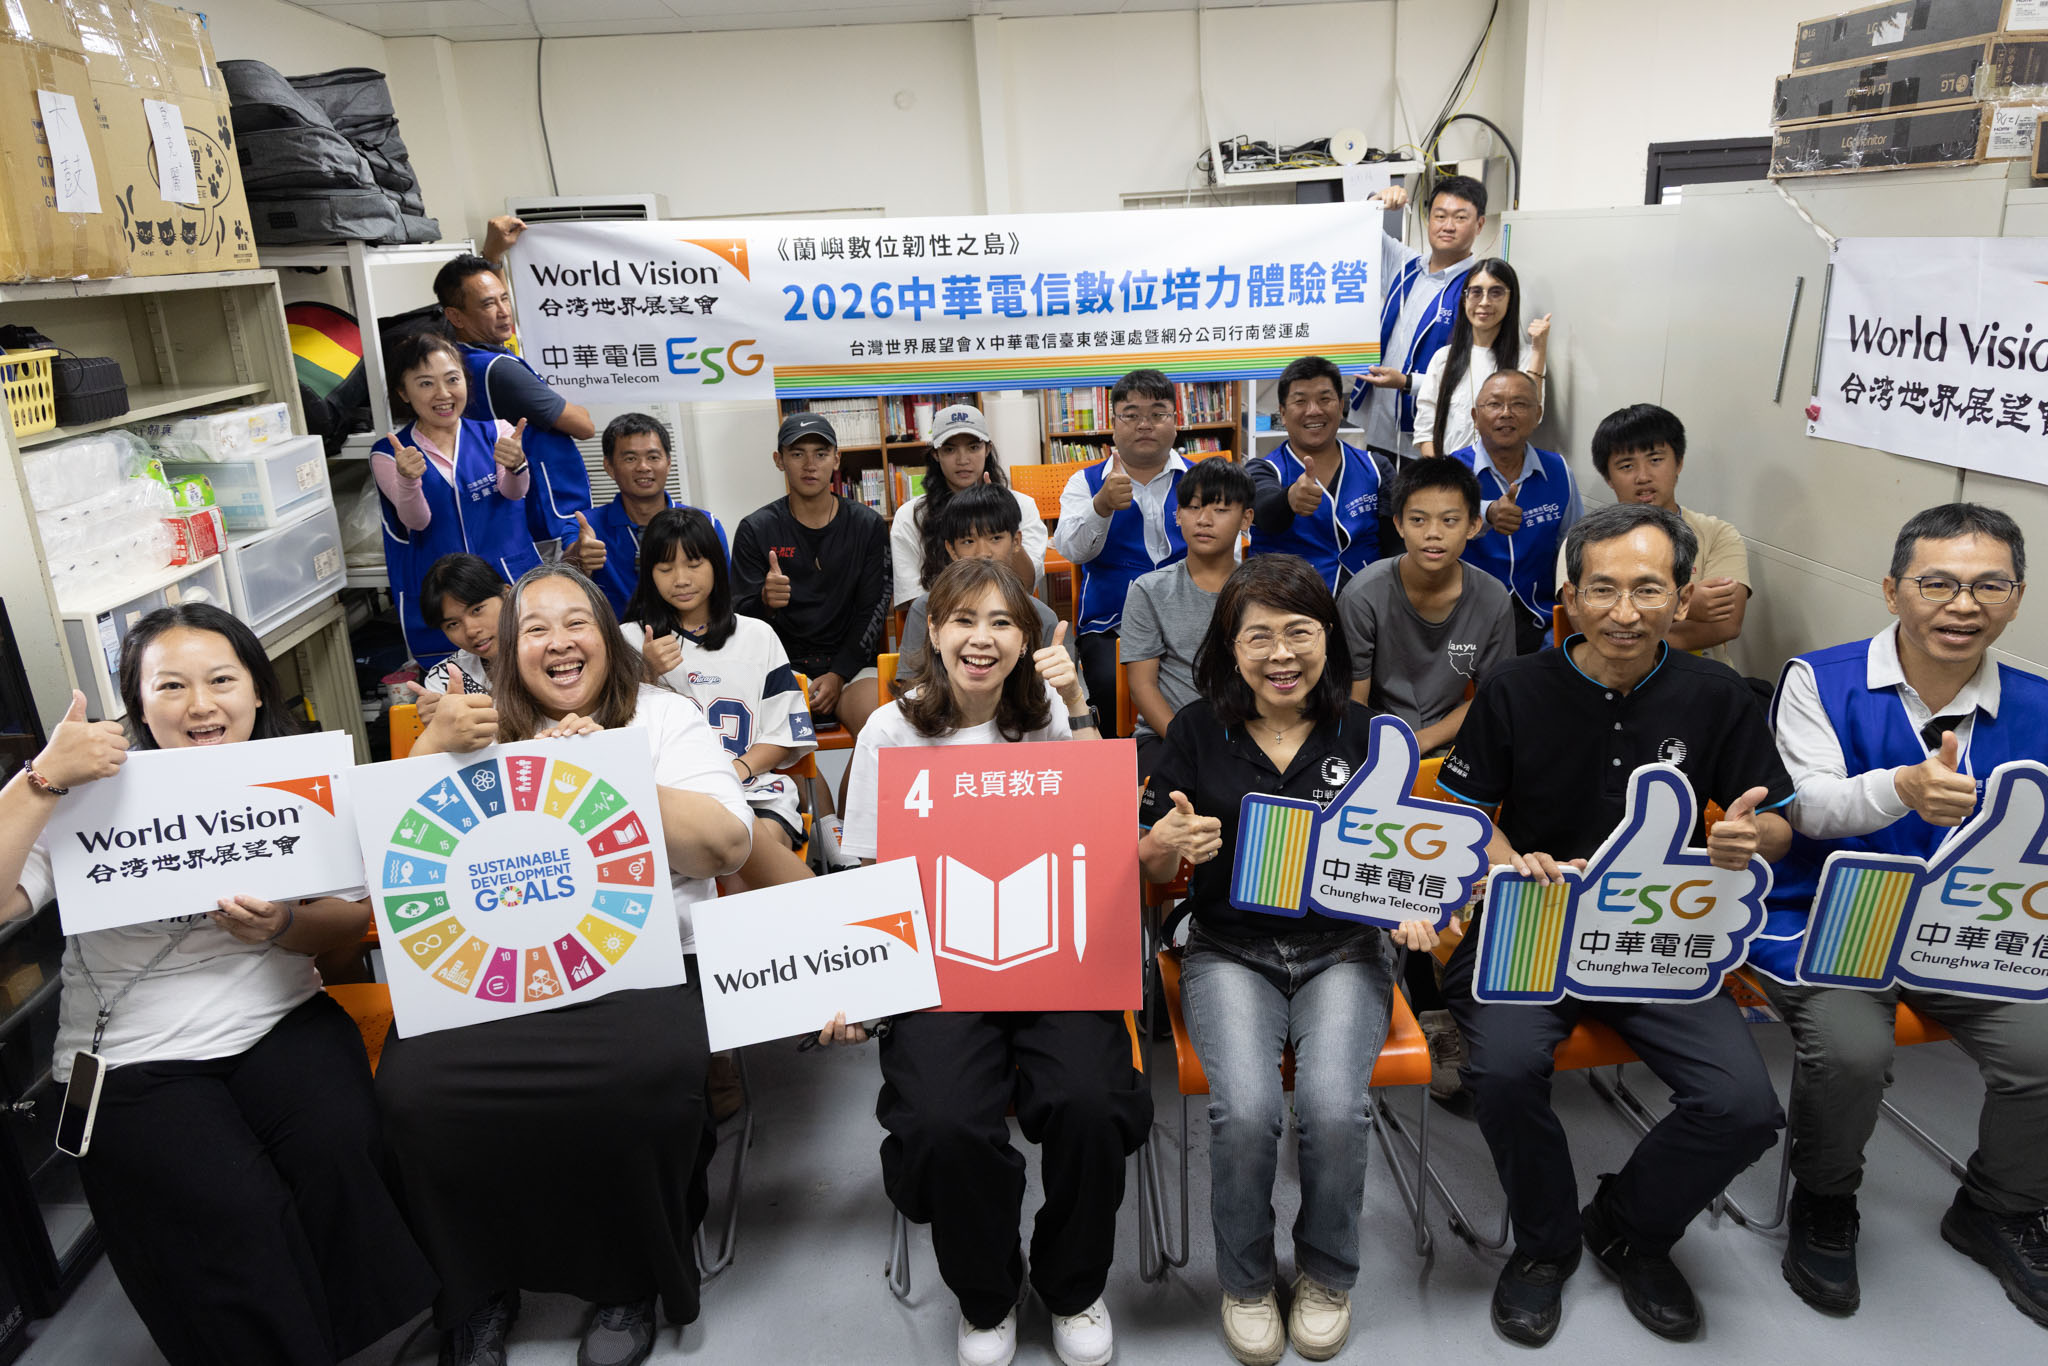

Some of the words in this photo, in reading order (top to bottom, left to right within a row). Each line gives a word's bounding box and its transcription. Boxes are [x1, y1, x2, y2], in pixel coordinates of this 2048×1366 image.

[777, 232, 1019, 262] 《蘭嶼數位韌性之島》
[530, 260, 620, 287] World
[628, 260, 719, 286] Vision
[783, 259, 1368, 322] 2026中華電信數位培力體驗營
[1849, 315, 1947, 362] World
[542, 344, 657, 369] 中華電信
[666, 337, 764, 384] ESG
[546, 374, 609, 388] Chunghwa
[611, 373, 660, 385] Telecom
[951, 412, 968, 422] CAP
[953, 769, 1063, 798] 良質教育
[521, 797, 527, 806] 1
[904, 769, 933, 817] 4
[489, 801, 498, 811] 17
[552, 801, 558, 811] 2
[76, 815, 187, 854] World
[195, 806, 300, 837] Vision
[462, 818, 472, 827] 16
[580, 820, 586, 829] 3
[1337, 805, 1448, 861] ESG
[440, 840, 449, 850] 15
[598, 843, 604, 852] 4
[468, 848, 571, 877] SUSTAINABLE
[428, 869, 439, 879] 14
[471, 863, 572, 890] DEVELOPMENT
[602, 867, 609, 877] 5
[1323, 858, 1447, 899] 中華電信
[434, 896, 445, 906] 13
[1320, 884, 1386, 905] Chunghwa
[1388, 895, 1441, 915] Telecom
[1597, 872, 1717, 925] ESG
[448, 924, 458, 934] 12
[586, 923, 592, 932] 7
[472, 942, 481, 951] 11
[562, 941, 568, 950] 8
[1579, 930, 1715, 959] 中華電信
[501, 952, 511, 961] 10
[533, 952, 539, 960] 9
[1911, 950, 1990, 970] Chunghwa
[713, 955, 798, 995] World
[803, 943, 889, 976] Vision
[1577, 959, 1648, 975] Chunghwa
[1651, 962, 1708, 976] Telecom
